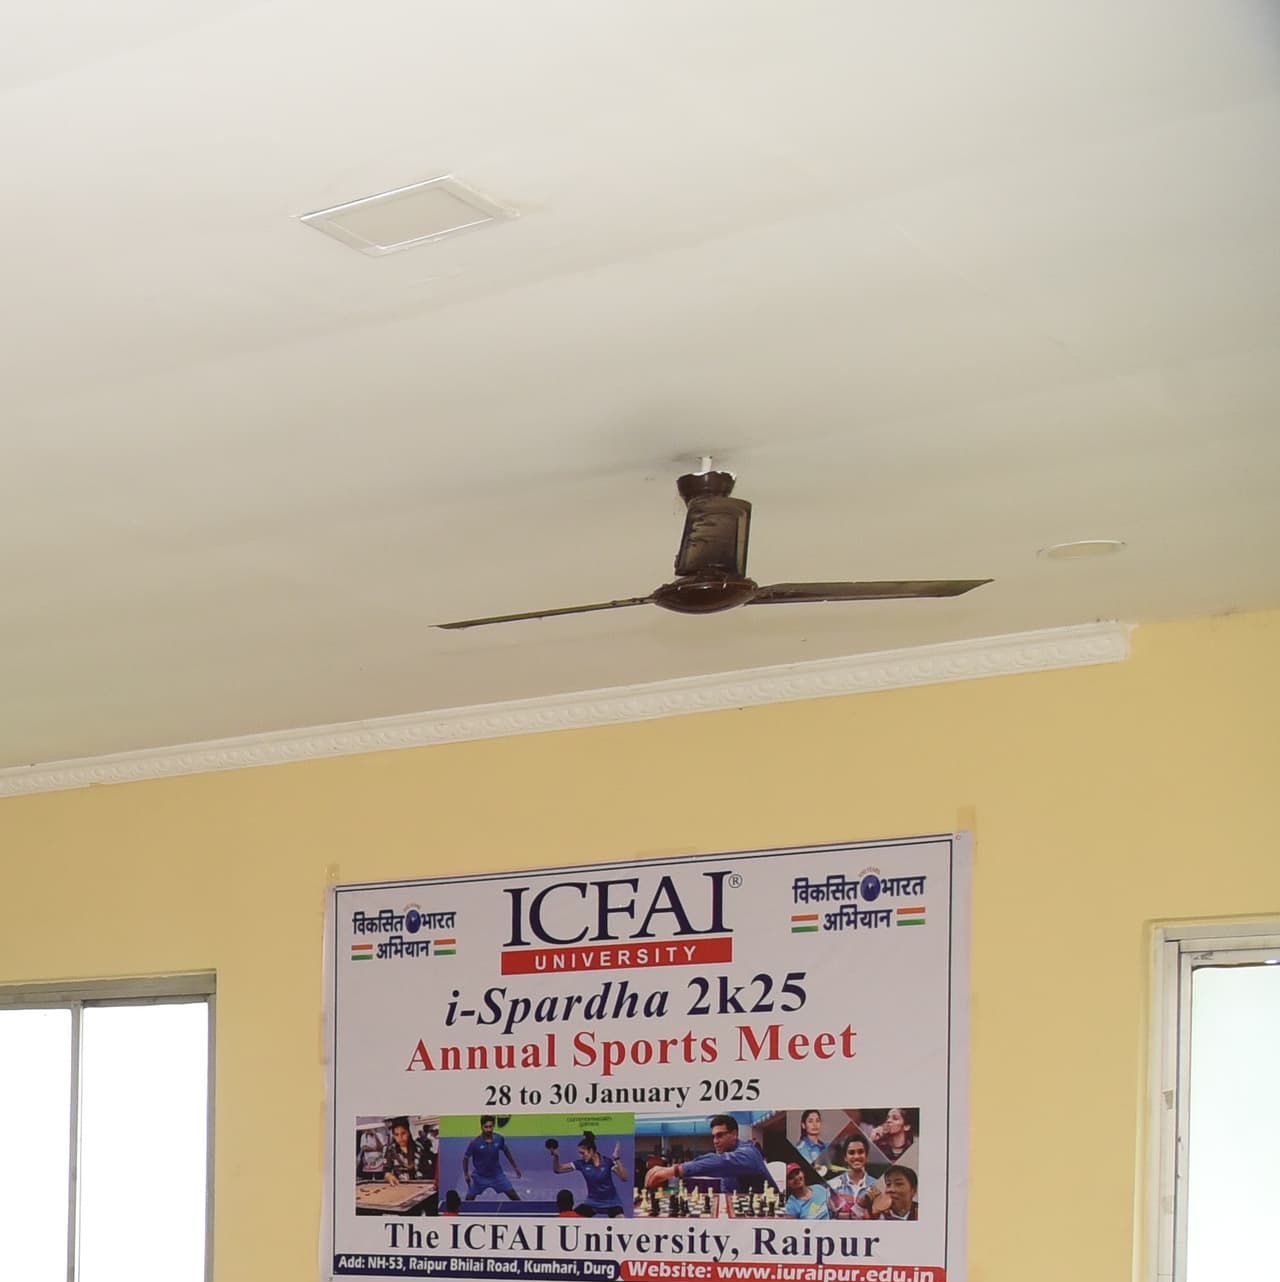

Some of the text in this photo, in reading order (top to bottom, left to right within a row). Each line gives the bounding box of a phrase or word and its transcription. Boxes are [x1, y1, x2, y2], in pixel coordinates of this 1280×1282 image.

[792, 875, 926, 904] विकसित भारत
[352, 909, 457, 935] विकसित भारत
[823, 904, 892, 931] अभियान
[376, 935, 431, 959] अभियान
[534, 945, 697, 970] UNIVERSITY
[445, 972, 807, 1035] i-Spardha 2k25
[405, 1023, 857, 1076] Annual Sports Meet
[485, 1079, 761, 1109] 28 to 30 January 2025
[385, 1223, 880, 1265] The ICFAI University, Raipur
[338, 1255, 615, 1279] Add: NH-53, Raipur Bhilai Road, Kumhari, Durg
[628, 1261, 712, 1279] Website:
